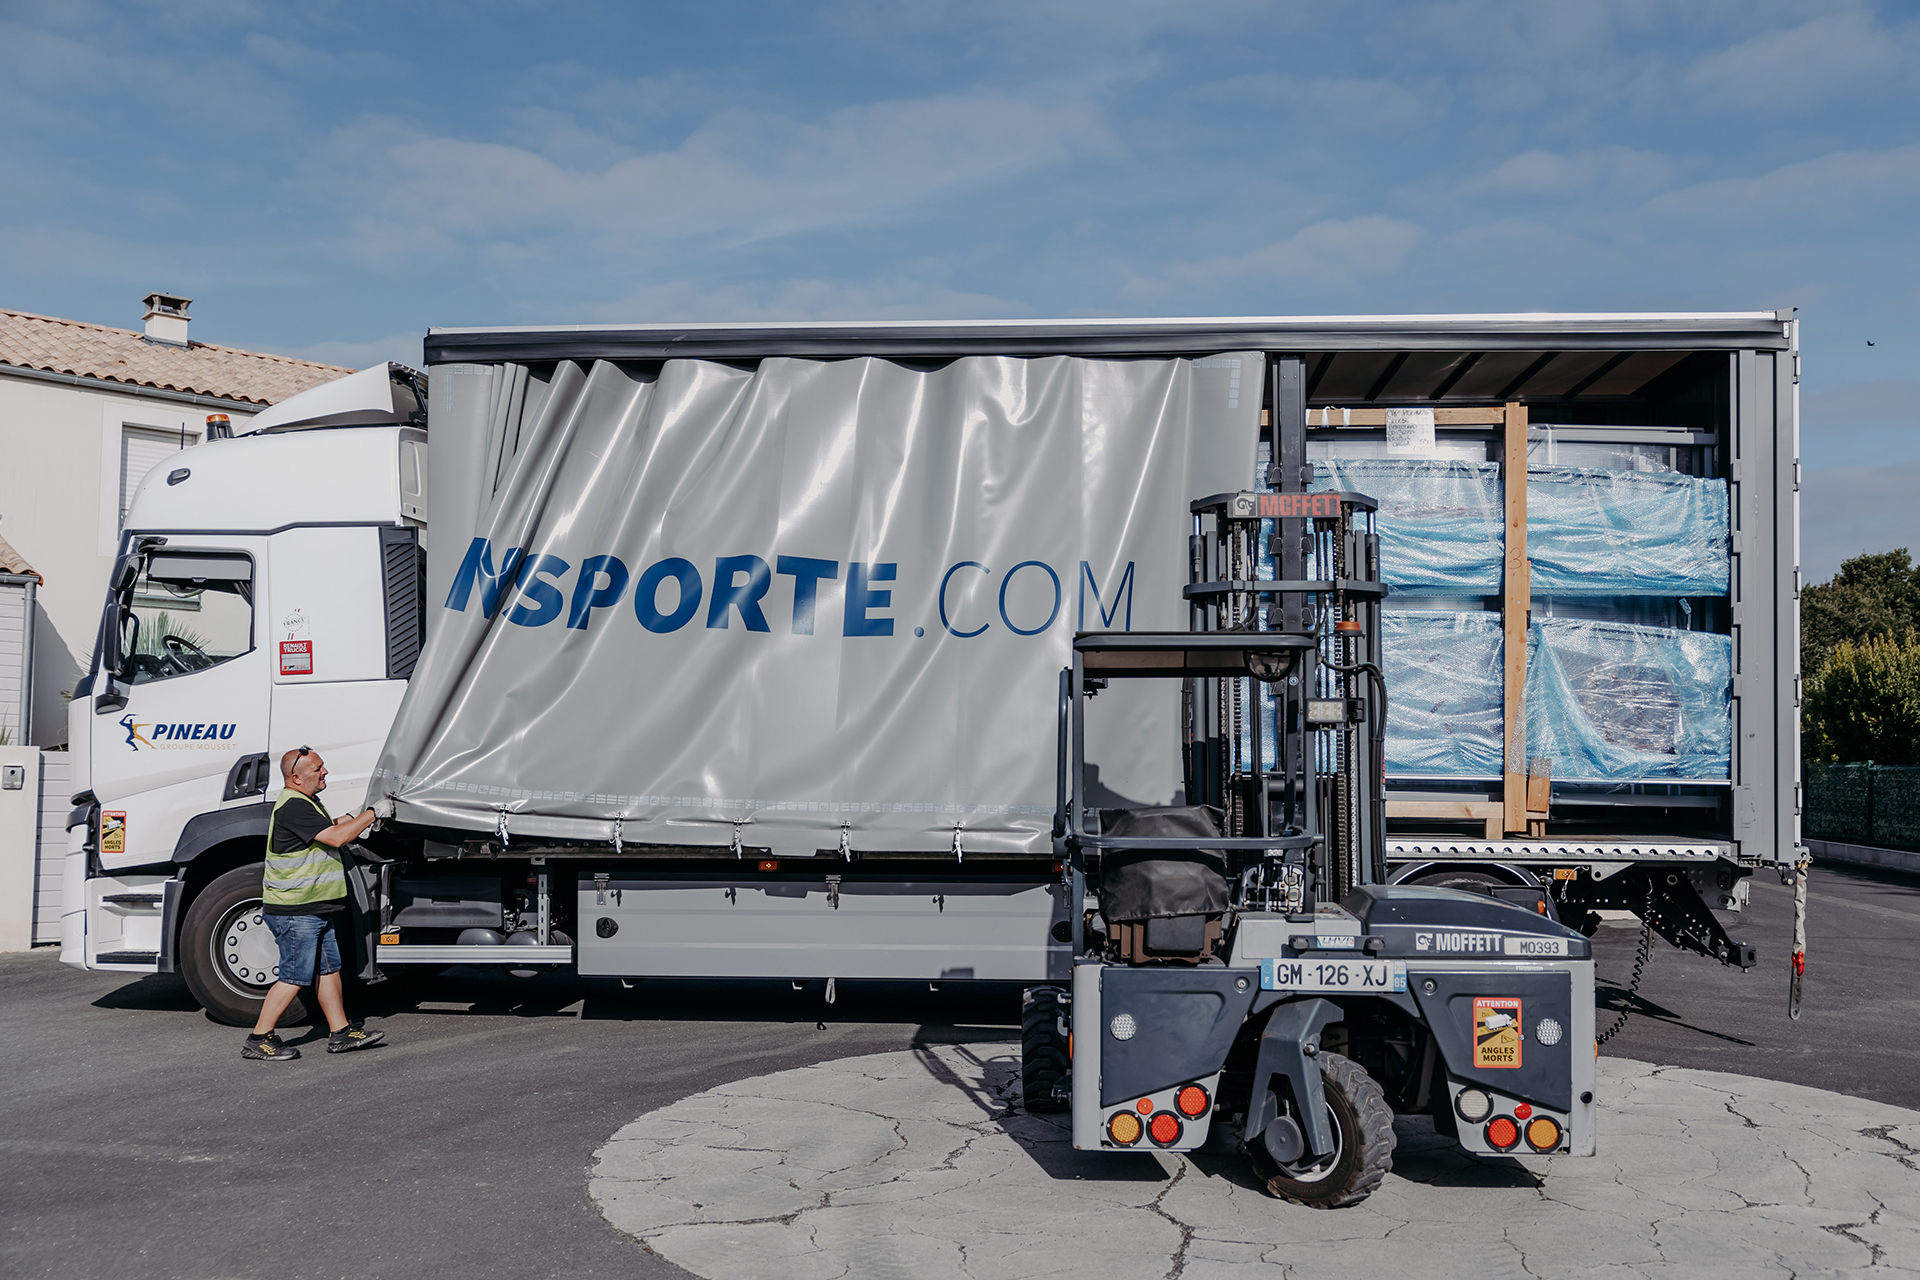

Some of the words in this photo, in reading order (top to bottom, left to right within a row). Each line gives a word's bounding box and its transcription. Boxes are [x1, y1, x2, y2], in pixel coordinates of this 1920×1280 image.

[1260, 495, 1341, 516] MOFFETT
[151, 723, 237, 740] PINEAU
[160, 743, 194, 751] GROUPE
[196, 743, 237, 751] MOUSSET
[1435, 933, 1503, 952] MOFFETT
[1393, 976, 1407, 989] 85
[1483, 1054, 1514, 1062] MORTS
